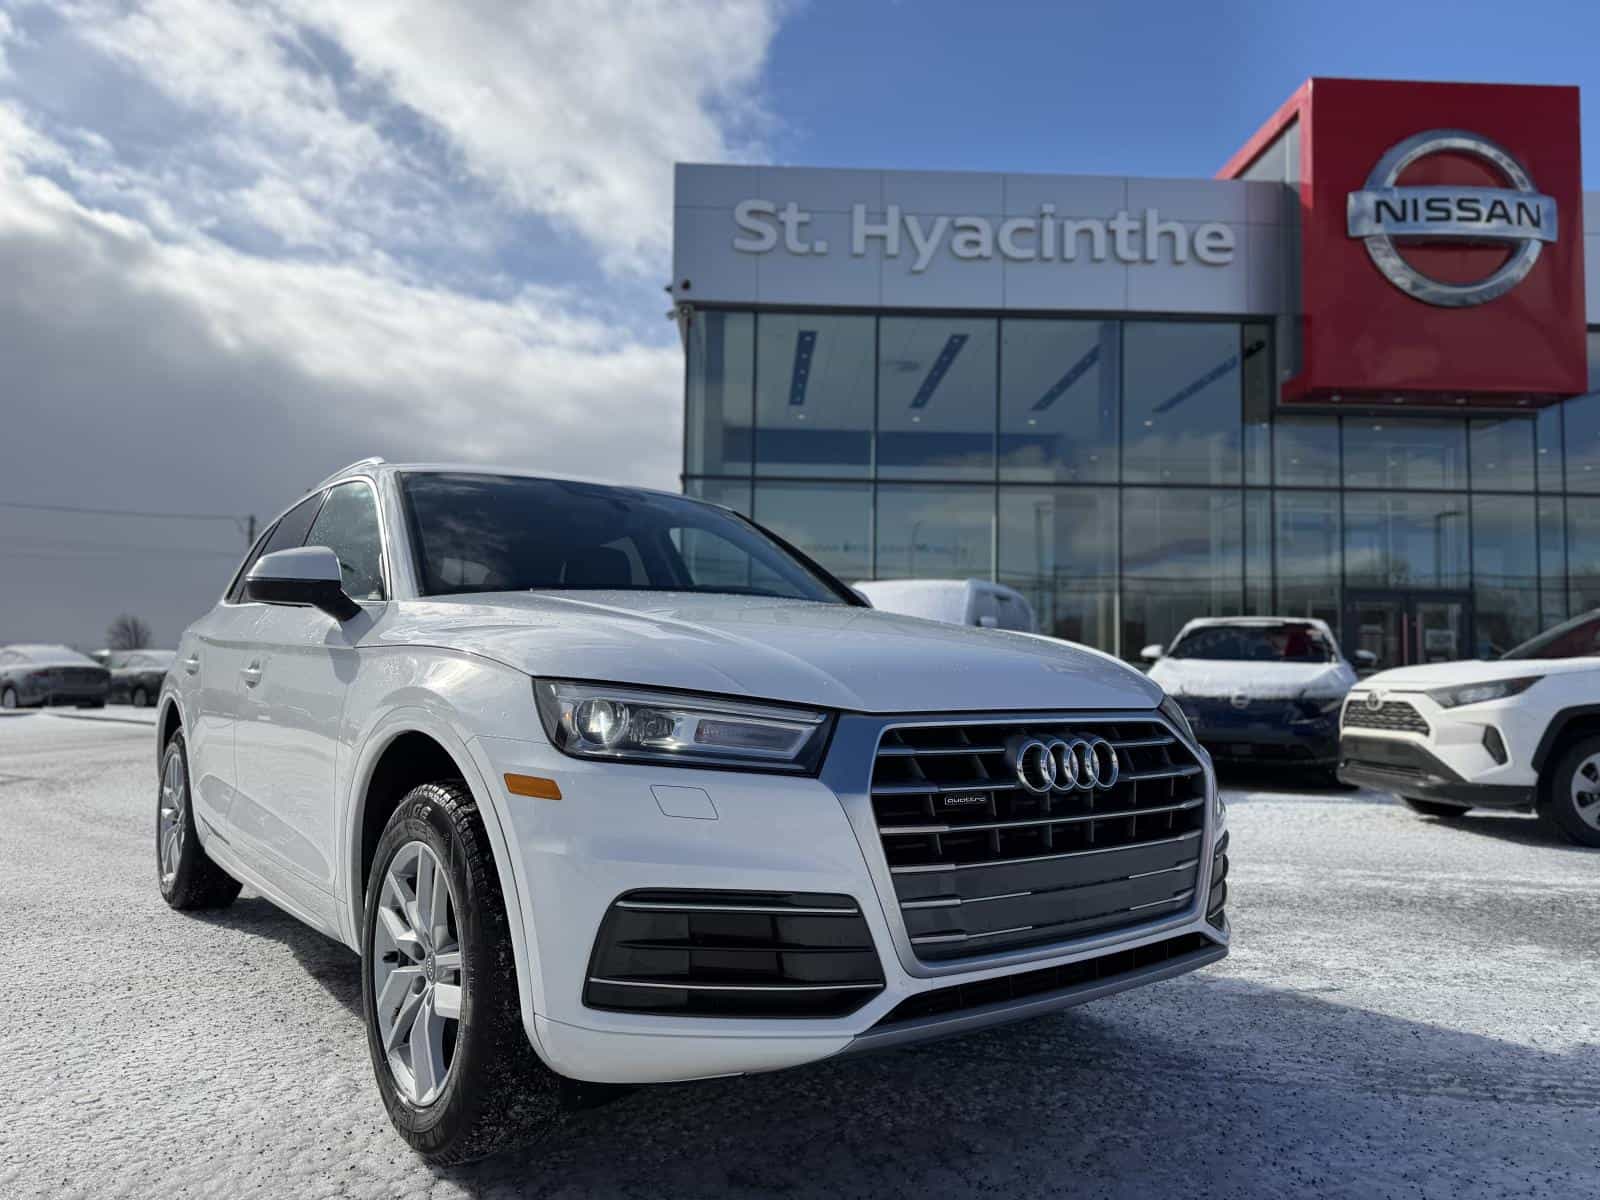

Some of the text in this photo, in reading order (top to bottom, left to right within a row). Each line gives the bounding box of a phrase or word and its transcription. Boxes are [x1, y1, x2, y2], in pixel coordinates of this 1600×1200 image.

[733, 200, 1235, 273] St. Hyacinthe
[1375, 197, 1541, 228] NISSAN
